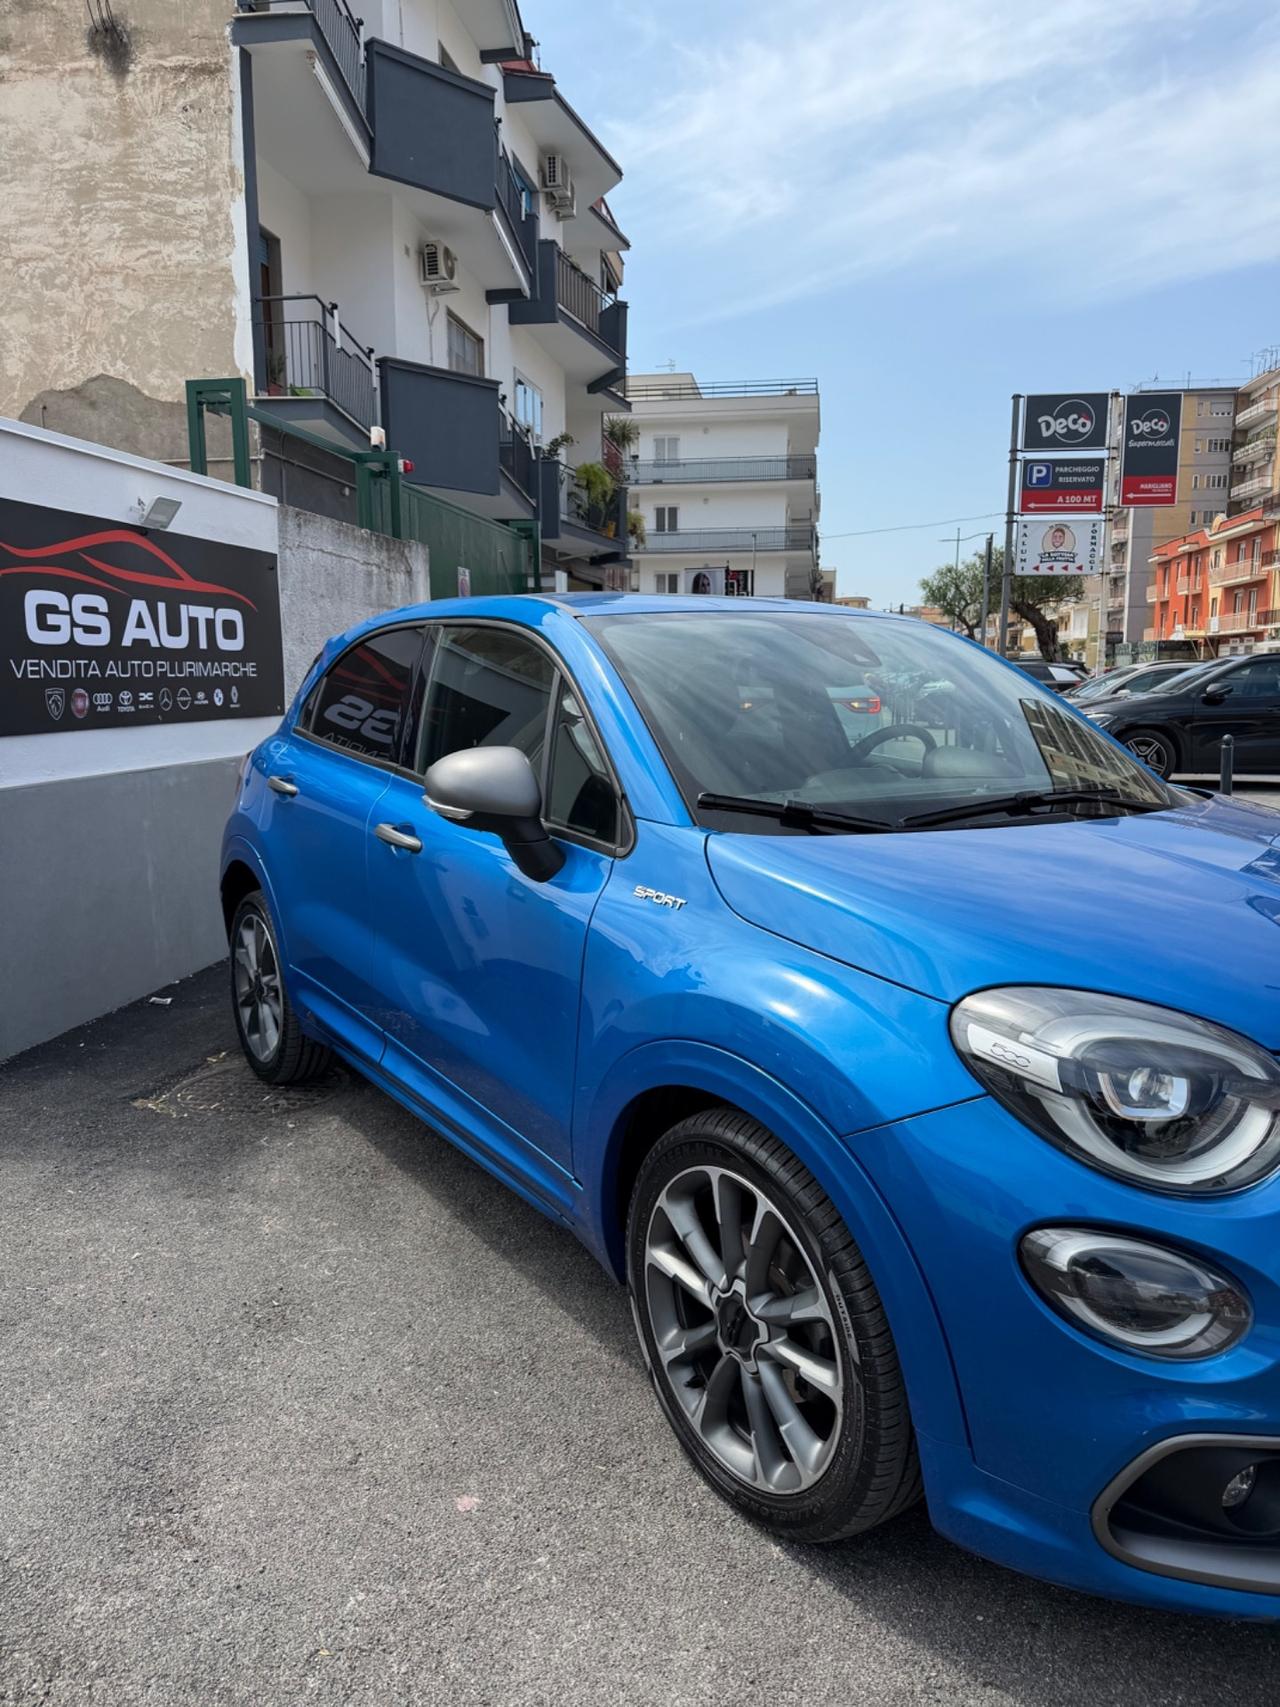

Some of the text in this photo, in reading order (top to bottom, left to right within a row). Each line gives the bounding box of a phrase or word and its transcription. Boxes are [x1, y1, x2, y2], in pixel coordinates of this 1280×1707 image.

[1032, 466, 1047, 484] P
[1055, 466, 1100, 474] PARCHEGGIO
[1082, 495, 1096, 503] MT
[1020, 523, 1028, 572] SALUMI
[1088, 523, 1098, 571] FORMAGGI
[24, 589, 245, 652] GS AUTO
[9, 659, 258, 678] VENDITA AUTO PLURIMARCHE
[633, 885, 687, 911] SPORT
[990, 1042, 1031, 1068] 500
